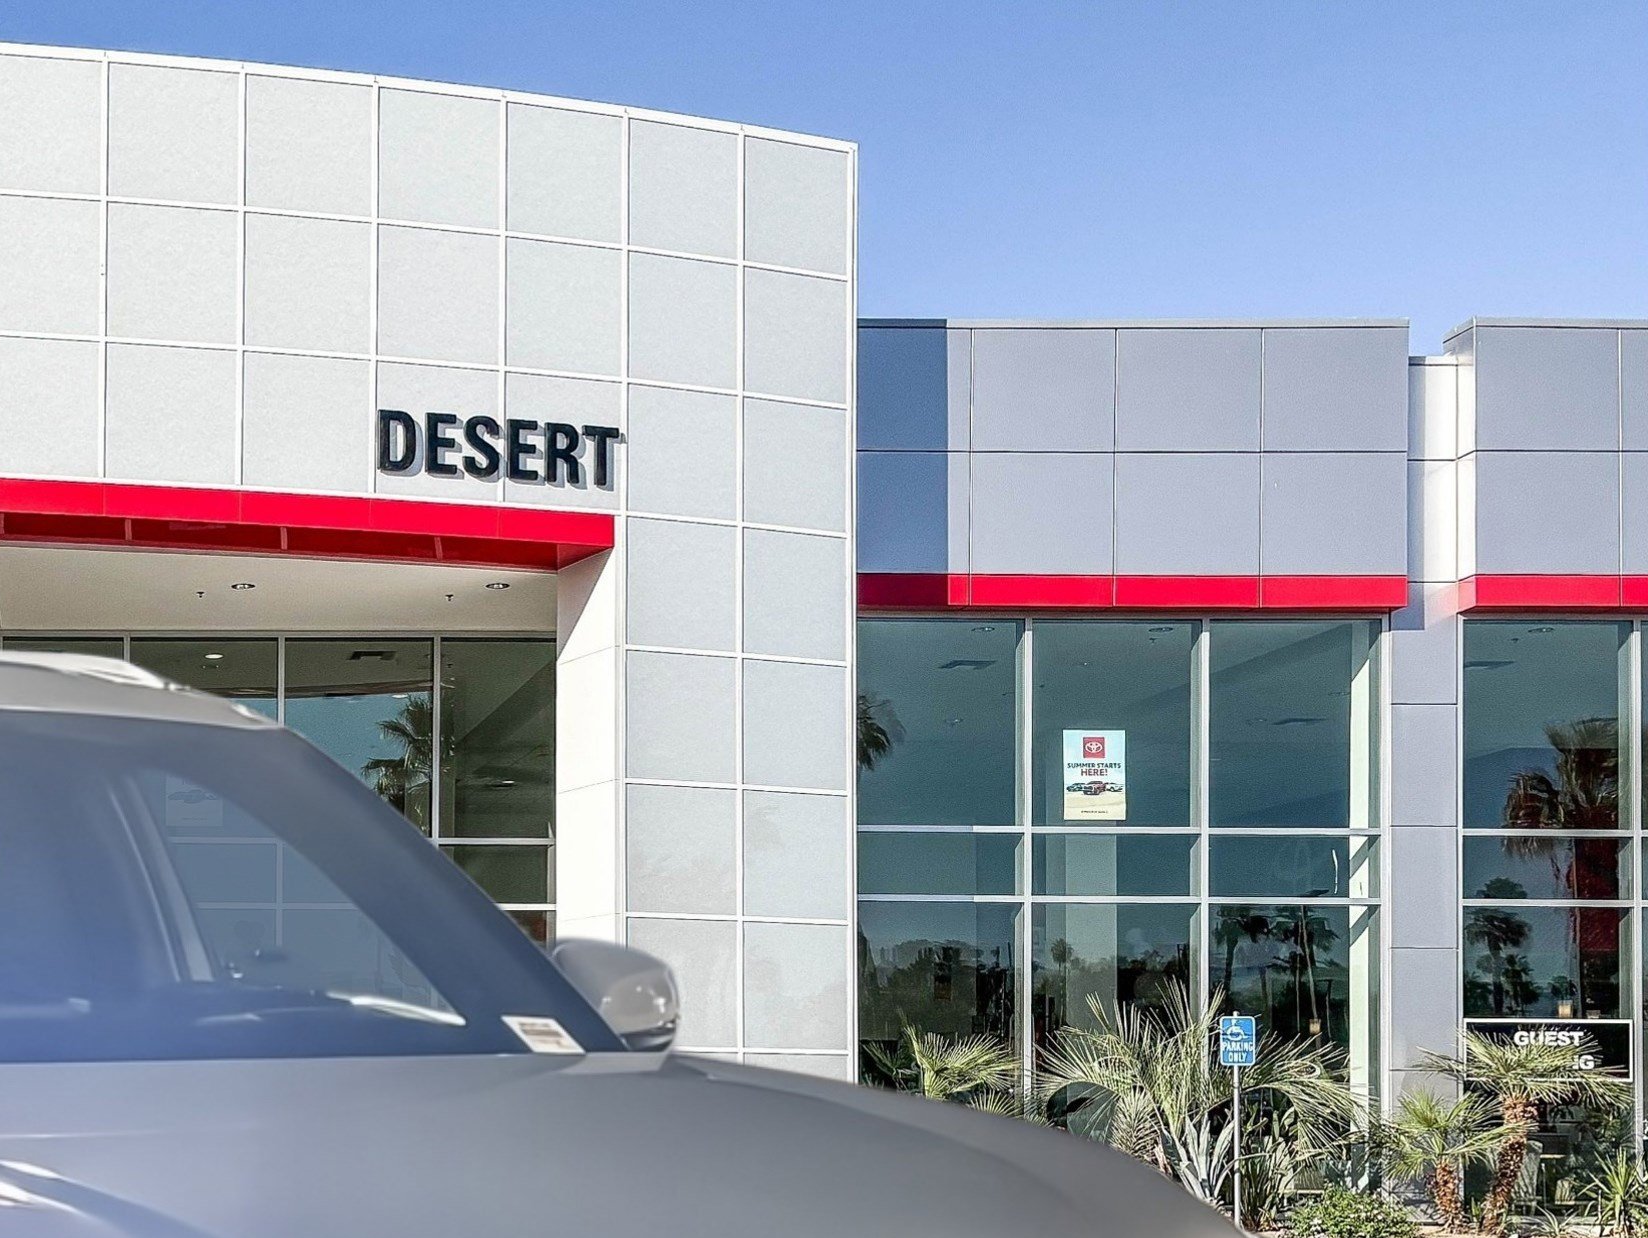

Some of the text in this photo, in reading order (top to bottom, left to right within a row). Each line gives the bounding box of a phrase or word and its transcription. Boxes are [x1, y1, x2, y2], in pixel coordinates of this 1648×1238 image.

[376, 409, 620, 487] DESERT
[1513, 1031, 1584, 1046] GUEST
[1222, 1041, 1254, 1051] PARKING
[1228, 1052, 1248, 1062] ONLY
